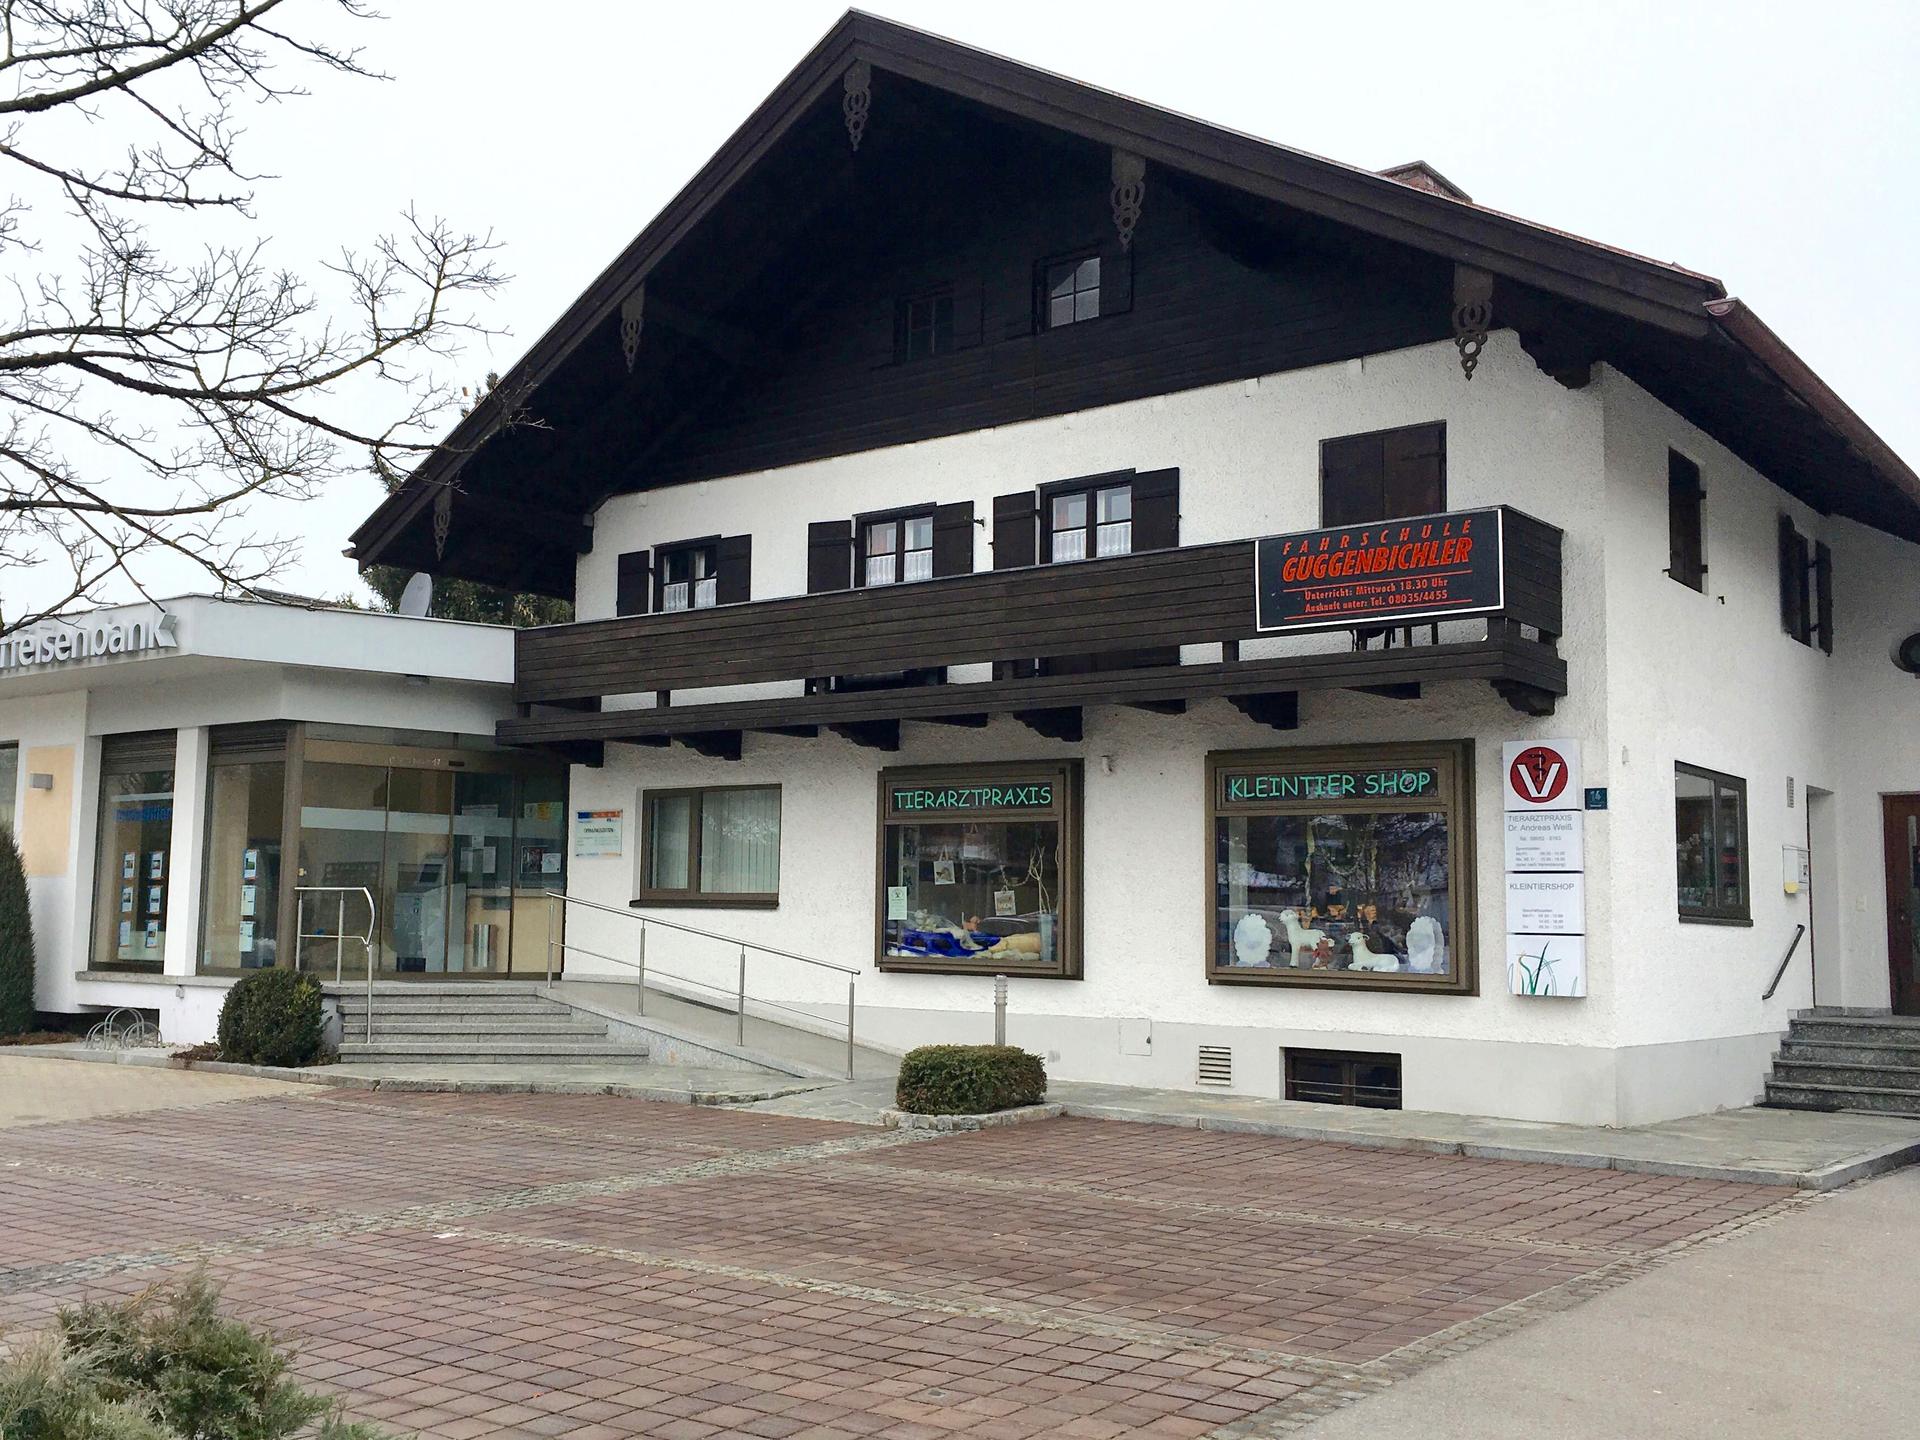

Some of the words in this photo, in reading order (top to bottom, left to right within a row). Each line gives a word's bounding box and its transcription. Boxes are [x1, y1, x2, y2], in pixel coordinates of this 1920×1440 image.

[1283, 519, 1472, 555] FAHRSCHULE
[1282, 537, 1473, 583] GUGGENBICHLER
[1305, 588, 1352, 601] Unterricht:
[1355, 582, 1396, 595] Mittwoch
[1400, 579, 1428, 591] 18.30
[1431, 577, 1448, 588] Uhr
[1305, 600, 1341, 612] Auskunft
[1343, 600, 1368, 609] unter:
[1370, 596, 1386, 607] Tel.
[1230, 774, 1356, 799] KLEINTIER
[1364, 771, 1431, 795] SHOP
[894, 787, 1052, 810] TIERARZTPRAXIS
[1508, 814, 1573, 822] TIERARZTPRAXIS
[1509, 882, 1575, 891] KLEINTIERSHOP
